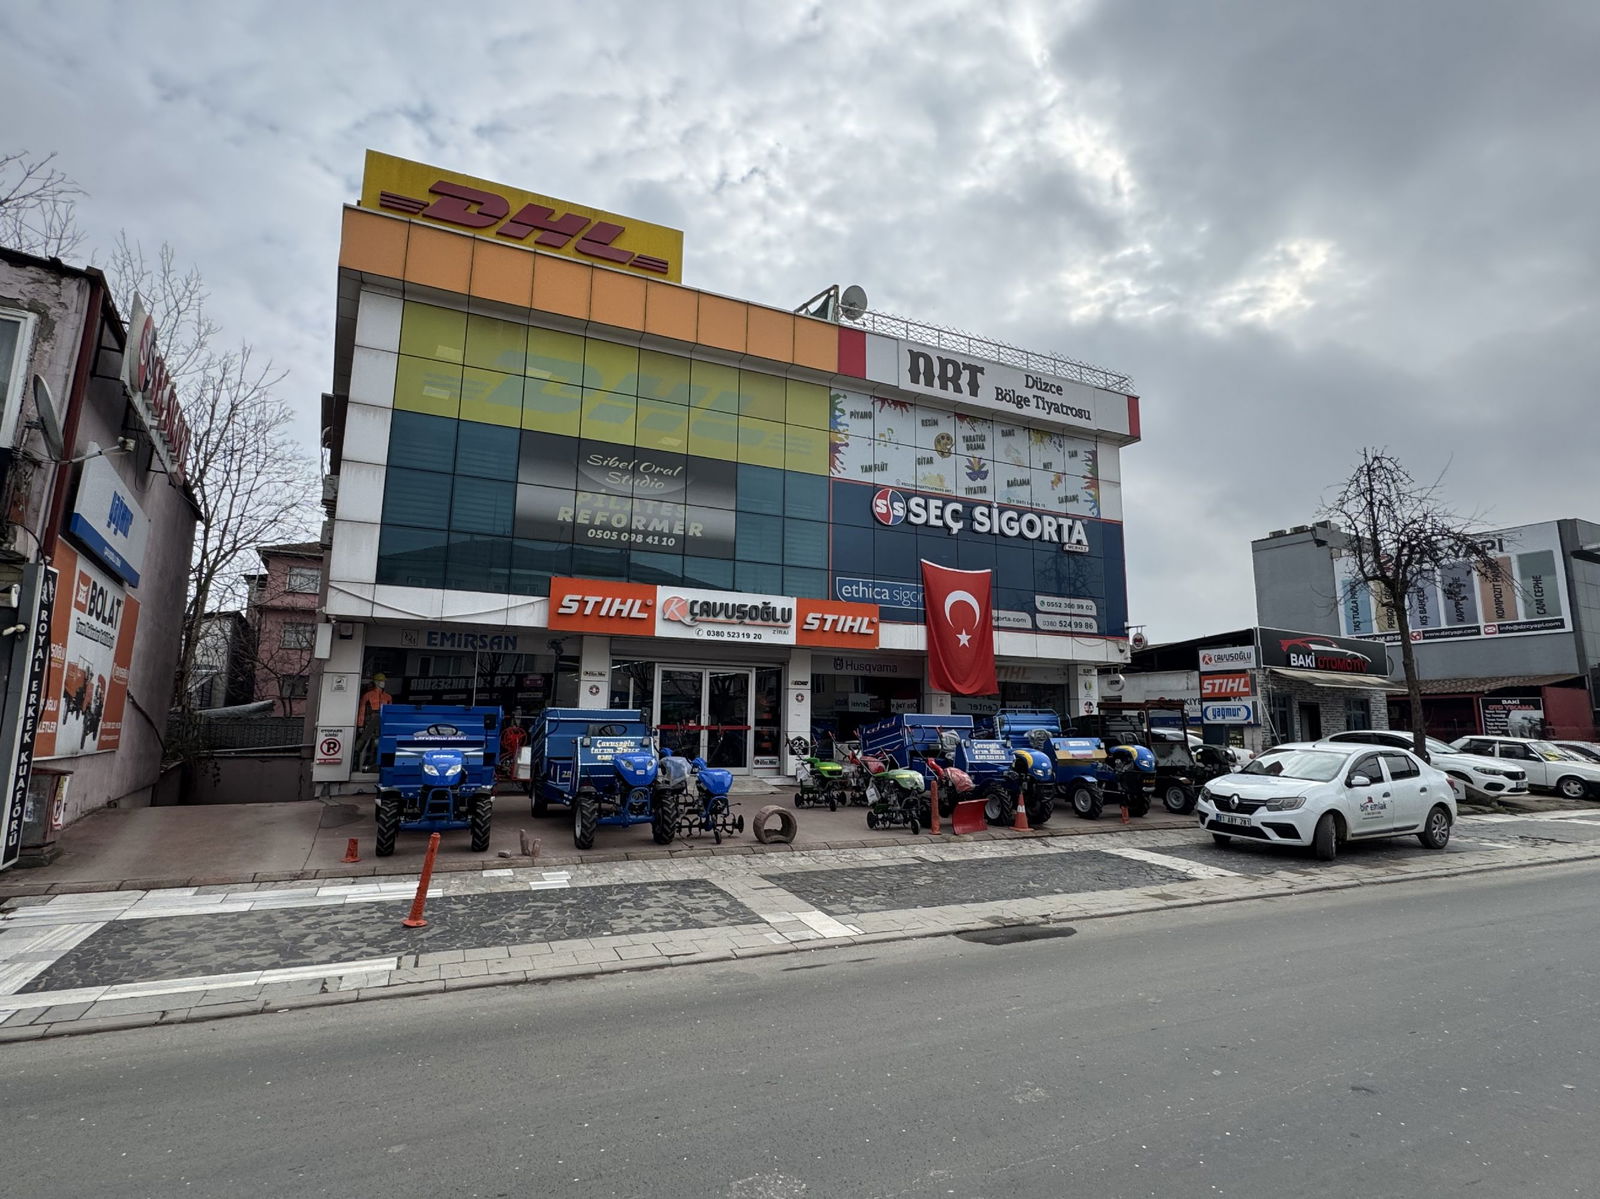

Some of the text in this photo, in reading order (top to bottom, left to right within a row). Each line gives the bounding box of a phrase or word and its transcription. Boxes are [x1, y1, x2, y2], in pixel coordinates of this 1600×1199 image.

[422, 180, 634, 264] DHL
[1025, 374, 1064, 396] Düzce
[486, 349, 766, 446] DHL
[995, 386, 1092, 421] Bölge Tiyatrosu
[850, 409, 873, 420] PİYANO
[921, 417, 939, 427] RESİM
[966, 443, 985, 451] DRAMA
[587, 454, 636, 471] Sibel
[861, 461, 889, 474] YAN FLÜT
[605, 471, 665, 490] Studio
[965, 486, 987, 495] TİYATRO
[1007, 478, 1030, 488] BAĞLAMA
[557, 506, 704, 537] REFORMER
[907, 497, 963, 535] SEÇ
[972, 502, 1089, 546] SİGORTA
[587, 529, 619, 541] 0505
[646, 536, 659, 545] 41
[661, 537, 676, 547] 10
[842, 581, 925, 606] ethica sigor
[1532, 574, 1548, 615] CAM CEPHE
[88, 580, 122, 631] BOLAT
[558, 594, 648, 619] STIHL
[690, 599, 793, 624] ÇAVUŞOĞLU
[802, 612, 875, 635] STIHL
[1058, 620, 1072, 628] 524
[1074, 621, 1083, 629] 99
[1085, 622, 1094, 630] 86
[34, 610, 49, 672] ROYAL
[426, 631, 518, 651] EMİRSAN
[707, 630, 725, 638] 0380
[727, 631, 741, 639] 523
[1290, 652, 1368, 673] BAKİ OTOMOTİV
[1202, 678, 1249, 694] STIHL
[23, 681, 39, 743] ERKEK
